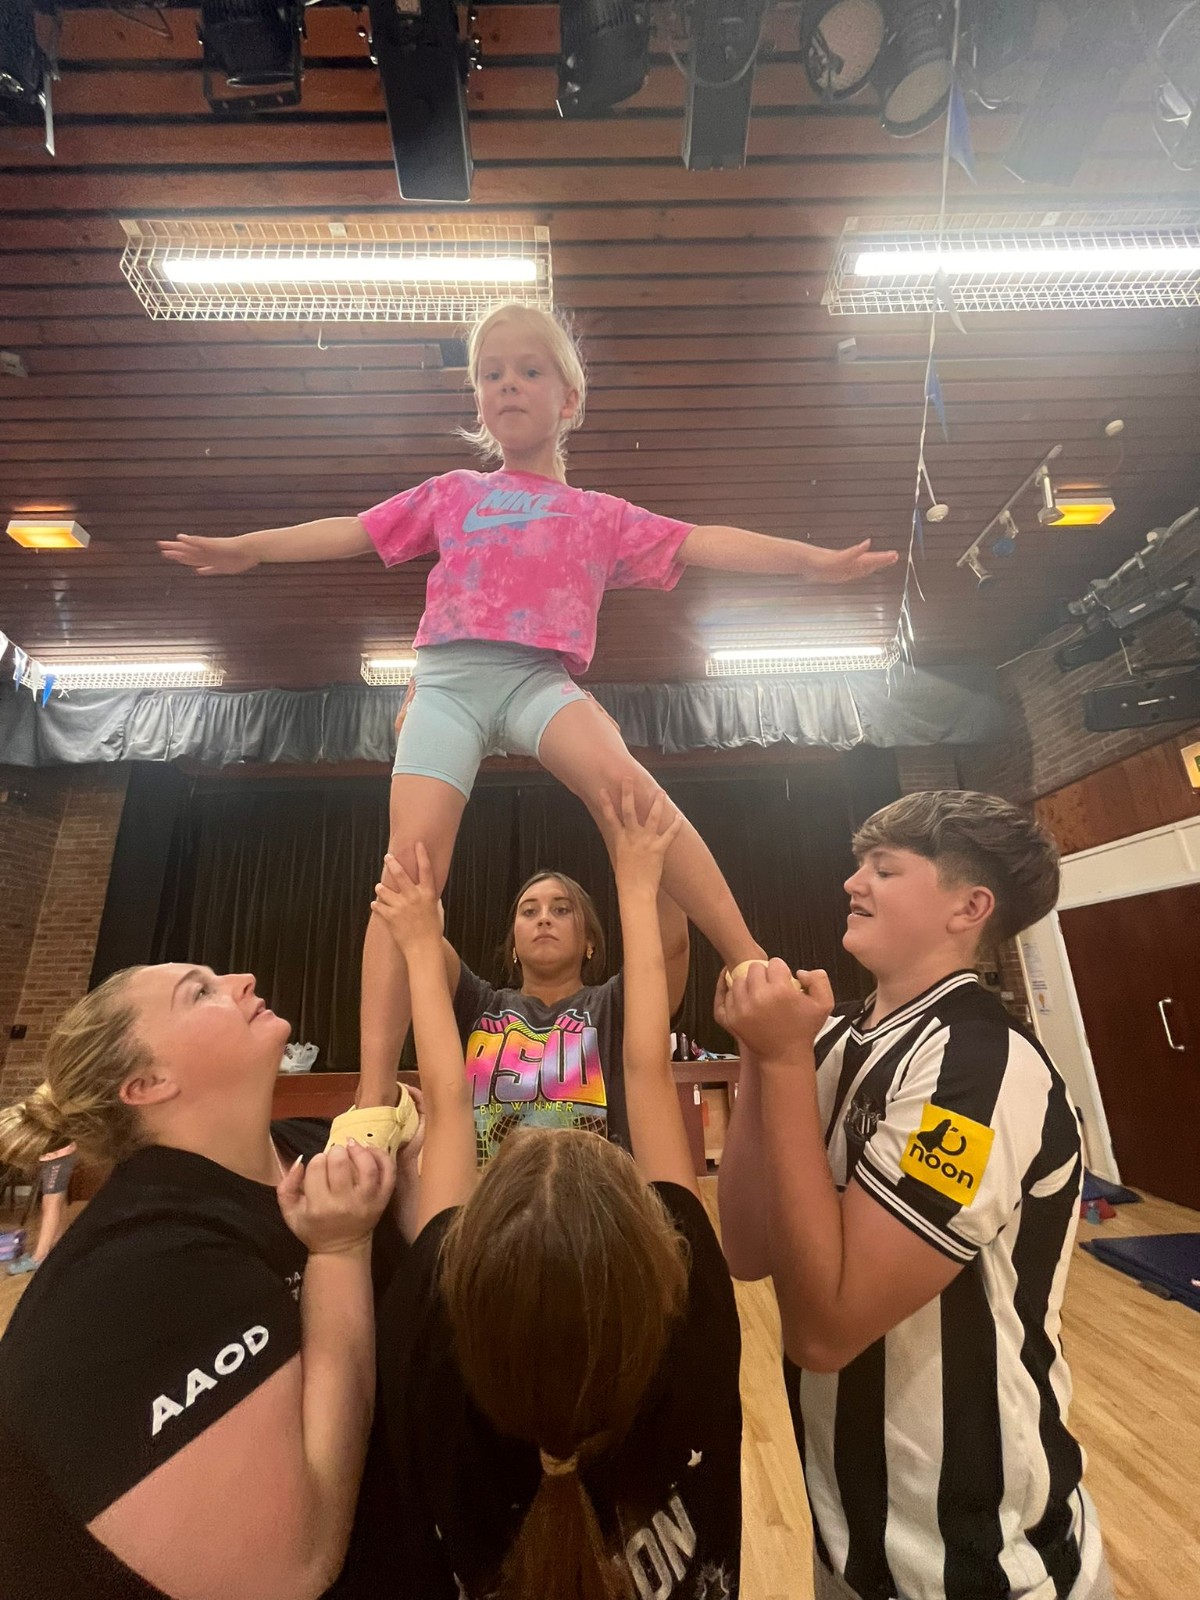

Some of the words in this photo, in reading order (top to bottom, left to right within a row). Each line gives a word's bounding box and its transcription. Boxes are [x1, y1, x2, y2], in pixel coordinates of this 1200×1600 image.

[479, 489, 557, 512] NIKE
[511, 1101, 574, 1113] WINNER
[909, 1143, 974, 1189] noon
[152, 1325, 269, 1436] AAOD
